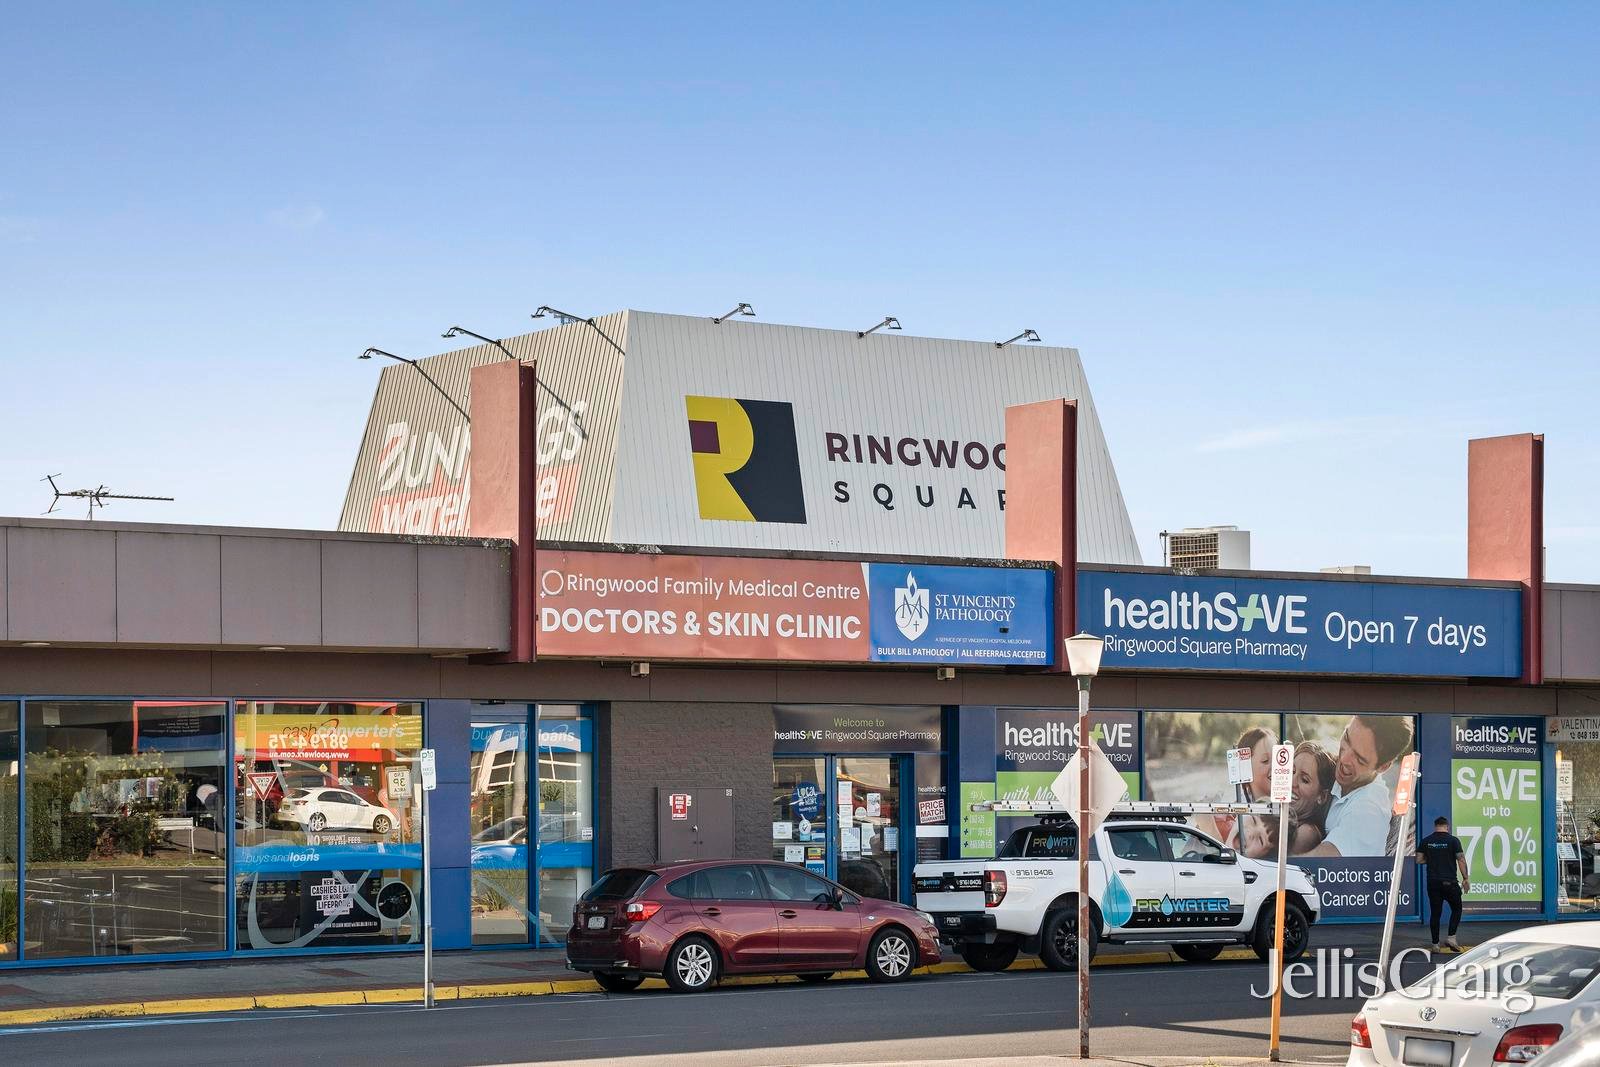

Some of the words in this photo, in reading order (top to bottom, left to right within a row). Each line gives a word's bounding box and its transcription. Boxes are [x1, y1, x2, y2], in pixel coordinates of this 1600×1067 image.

[567, 574, 658, 598] Ringwood
[664, 577, 723, 600] Family
[729, 578, 798, 598] Medical
[800, 581, 861, 600] Centre
[935, 594, 949, 607] ST
[952, 595, 1015, 608] VINCENT'S
[935, 608, 1013, 622] PATHOLOGY
[541, 608, 678, 635] DOCTORS
[684, 612, 701, 635] &
[708, 612, 770, 638] SKIN
[776, 614, 862, 639] CLINIC
[1324, 611, 1394, 650] Open
[1404, 616, 1418, 644] 7
[1427, 617, 1487, 654] days
[877, 647, 896, 656] BULK
[897, 648, 911, 656] BILL
[912, 648, 955, 657] PATHOLOGY
[961, 650, 973, 658] ALL
[974, 650, 1011, 658] REFERRALS
[1012, 650, 1046, 659] ACCEPTED
[1104, 635, 1177, 656] Ringwood
[1180, 636, 1232, 658] Square
[1235, 638, 1308, 660] Pharmacy
[833, 717, 873, 727] Welcome
[875, 717, 885, 727] to
[825, 730, 866, 742] Ringwood
[868, 730, 898, 742] Square
[899, 730, 942, 741] Pharmacy
[1005, 750, 1051, 763] Ringwood
[1456, 744, 1485, 753] Ringwood
[1486, 744, 1506, 754] Square
[1507, 745, 1536, 755] Pharmacy
[1456, 766, 1536, 801] SAVE
[919, 800, 944, 811] PRICE
[1482, 806, 1496, 818] up
[1499, 805, 1511, 816] to
[920, 809, 945, 818] MATCH
[1318, 867, 1370, 883] Doctors
[1513, 860, 1536, 876] on
[312, 885, 338, 895] CASHIES
[1322, 890, 1370, 906] Cancer
[1373, 890, 1410, 906] Cliic
